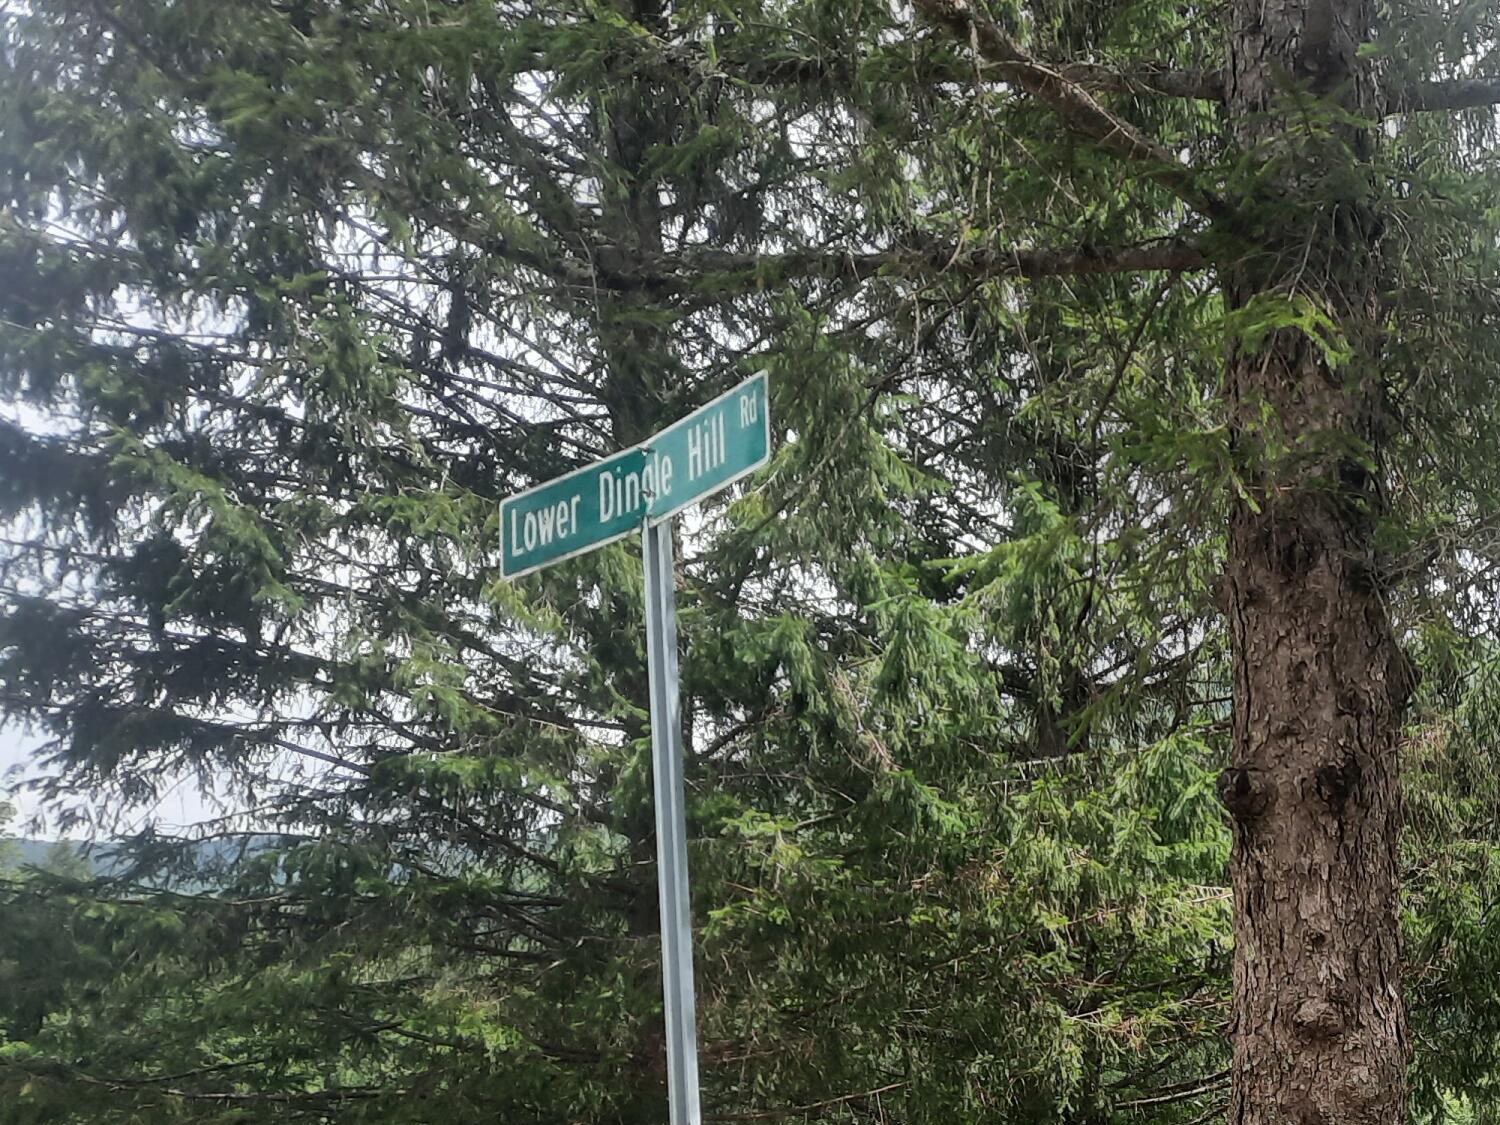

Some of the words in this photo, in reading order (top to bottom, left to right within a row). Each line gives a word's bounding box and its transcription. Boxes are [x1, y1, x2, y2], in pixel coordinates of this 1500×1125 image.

[511, 494, 581, 557] Lower
[600, 453, 673, 523] Dingle
[687, 411, 725, 481] Hill
[740, 390, 758, 429] Rd
